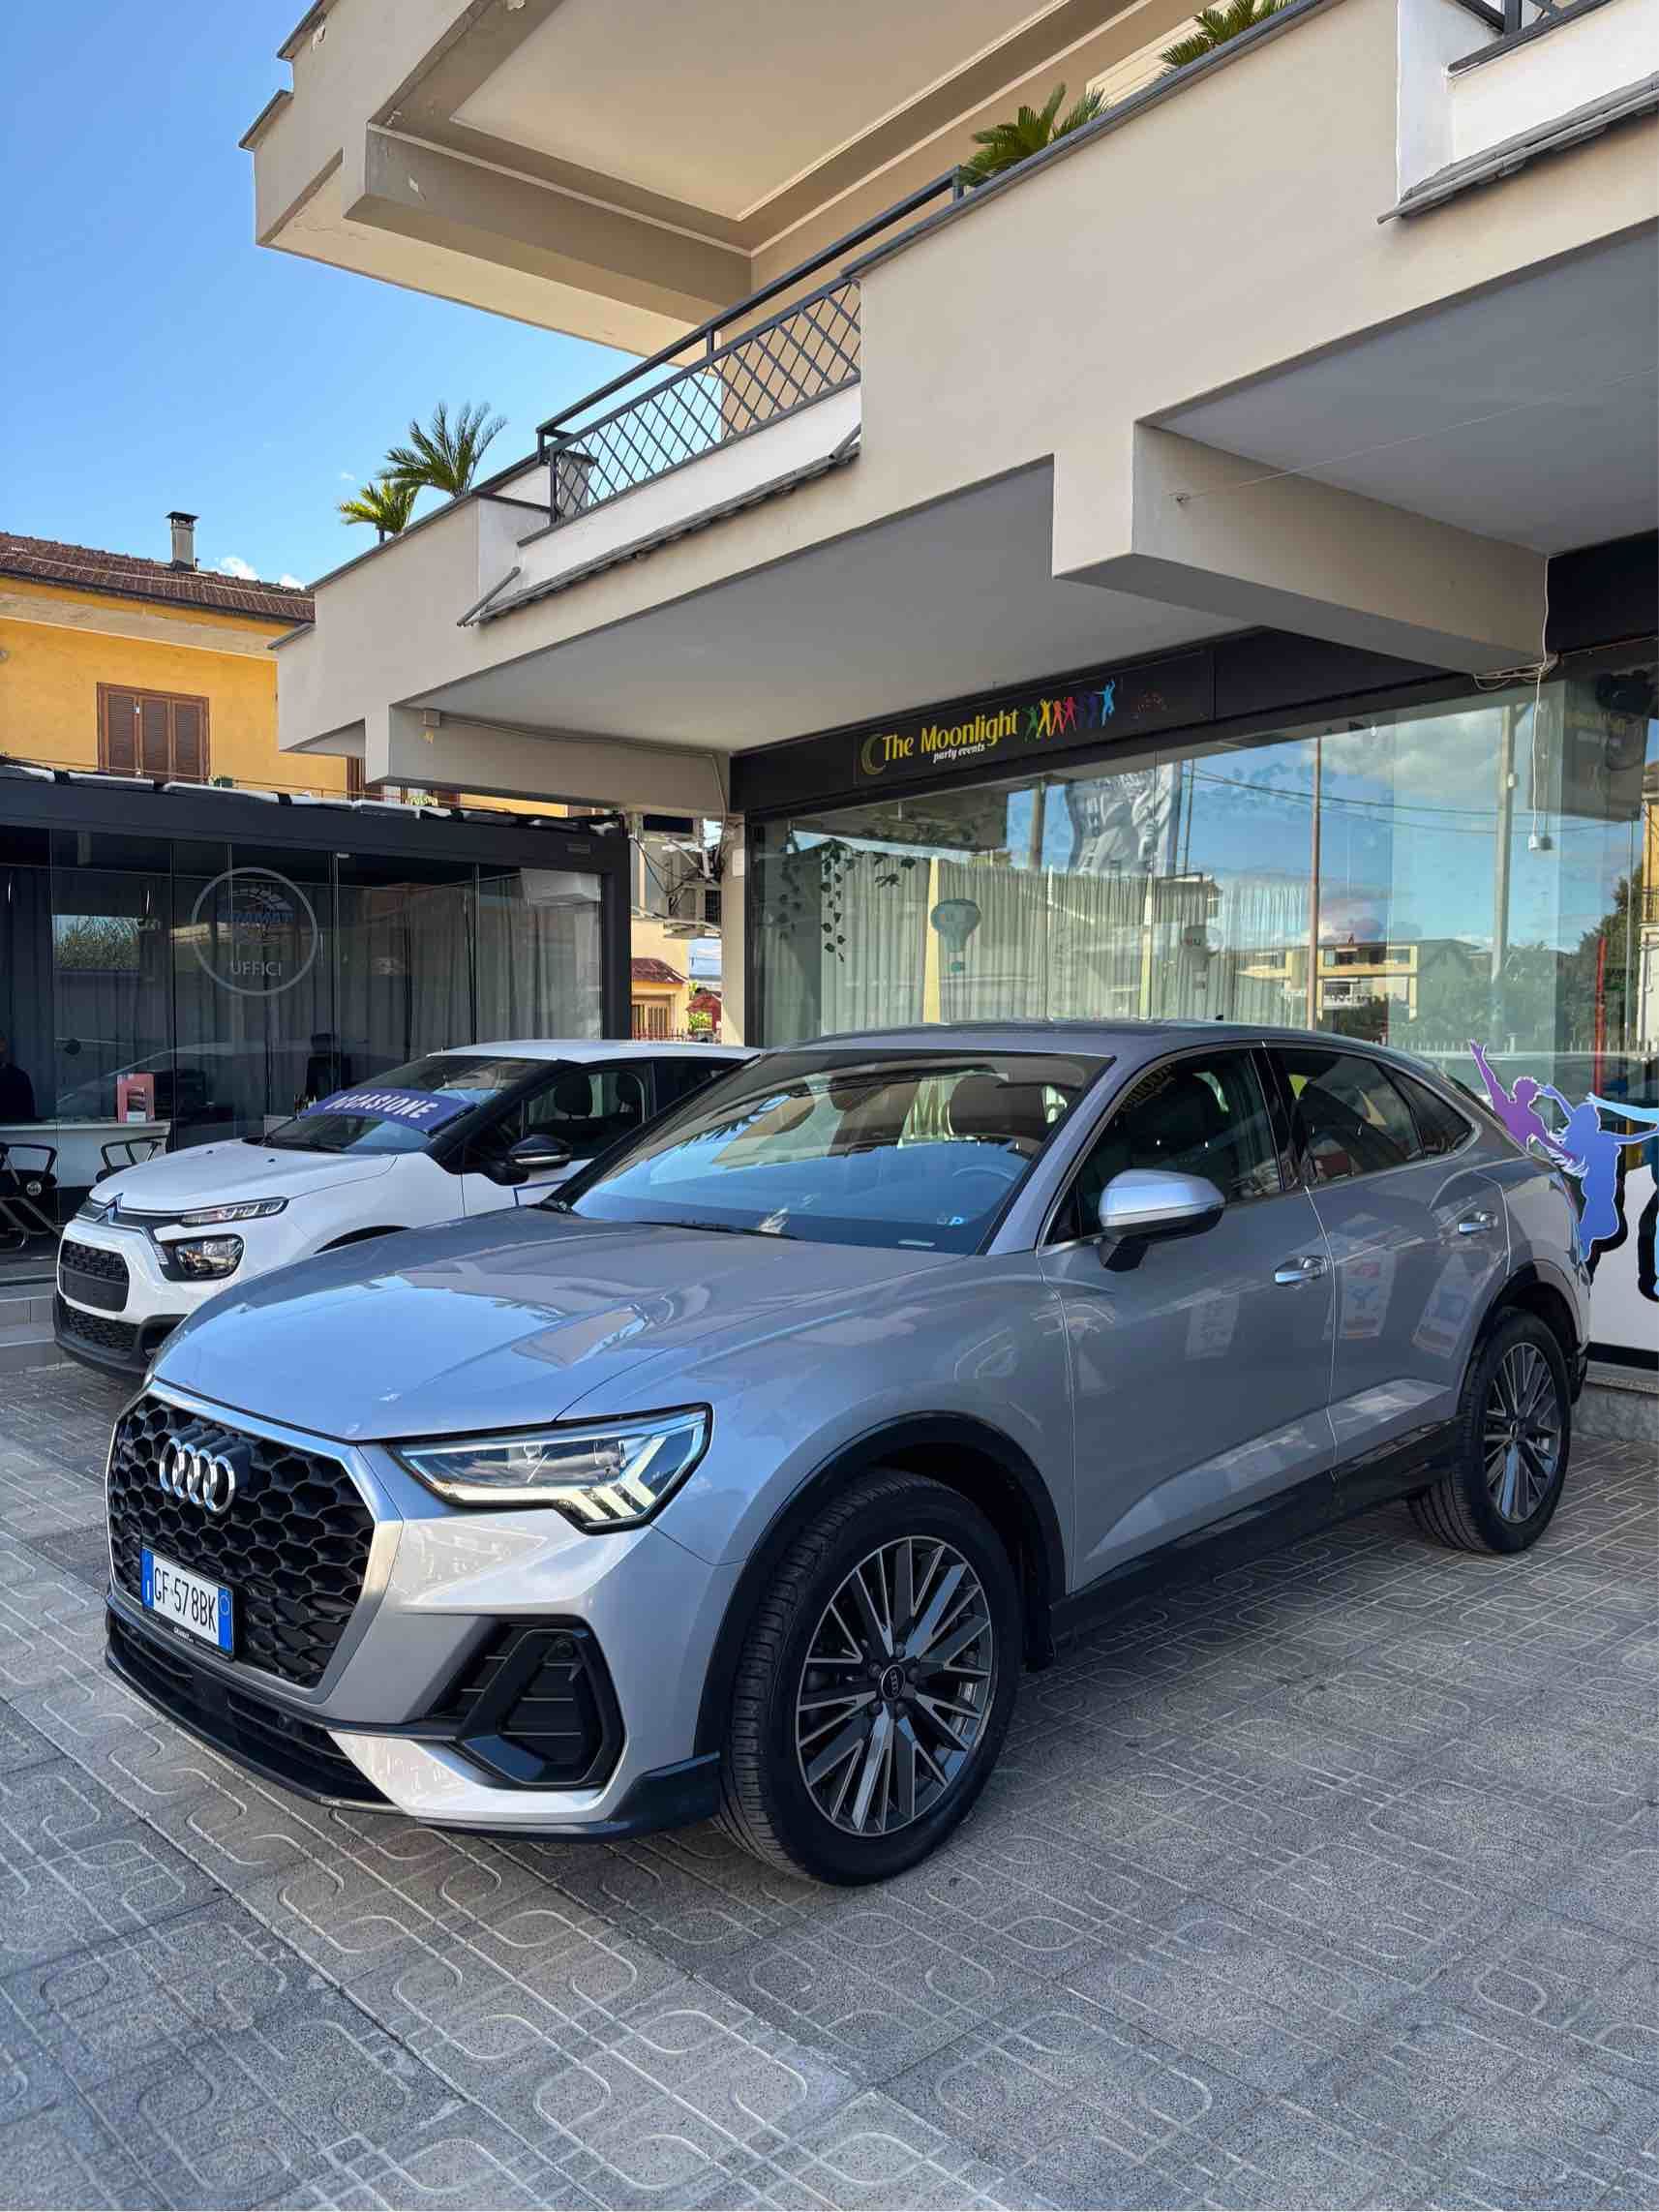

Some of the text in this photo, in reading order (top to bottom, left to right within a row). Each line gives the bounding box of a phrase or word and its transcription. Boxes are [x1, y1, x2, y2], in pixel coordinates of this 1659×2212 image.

[883, 710, 1018, 761] The Moonlight
[933, 742, 985, 764] party events
[230, 959, 282, 977] UFFICI
